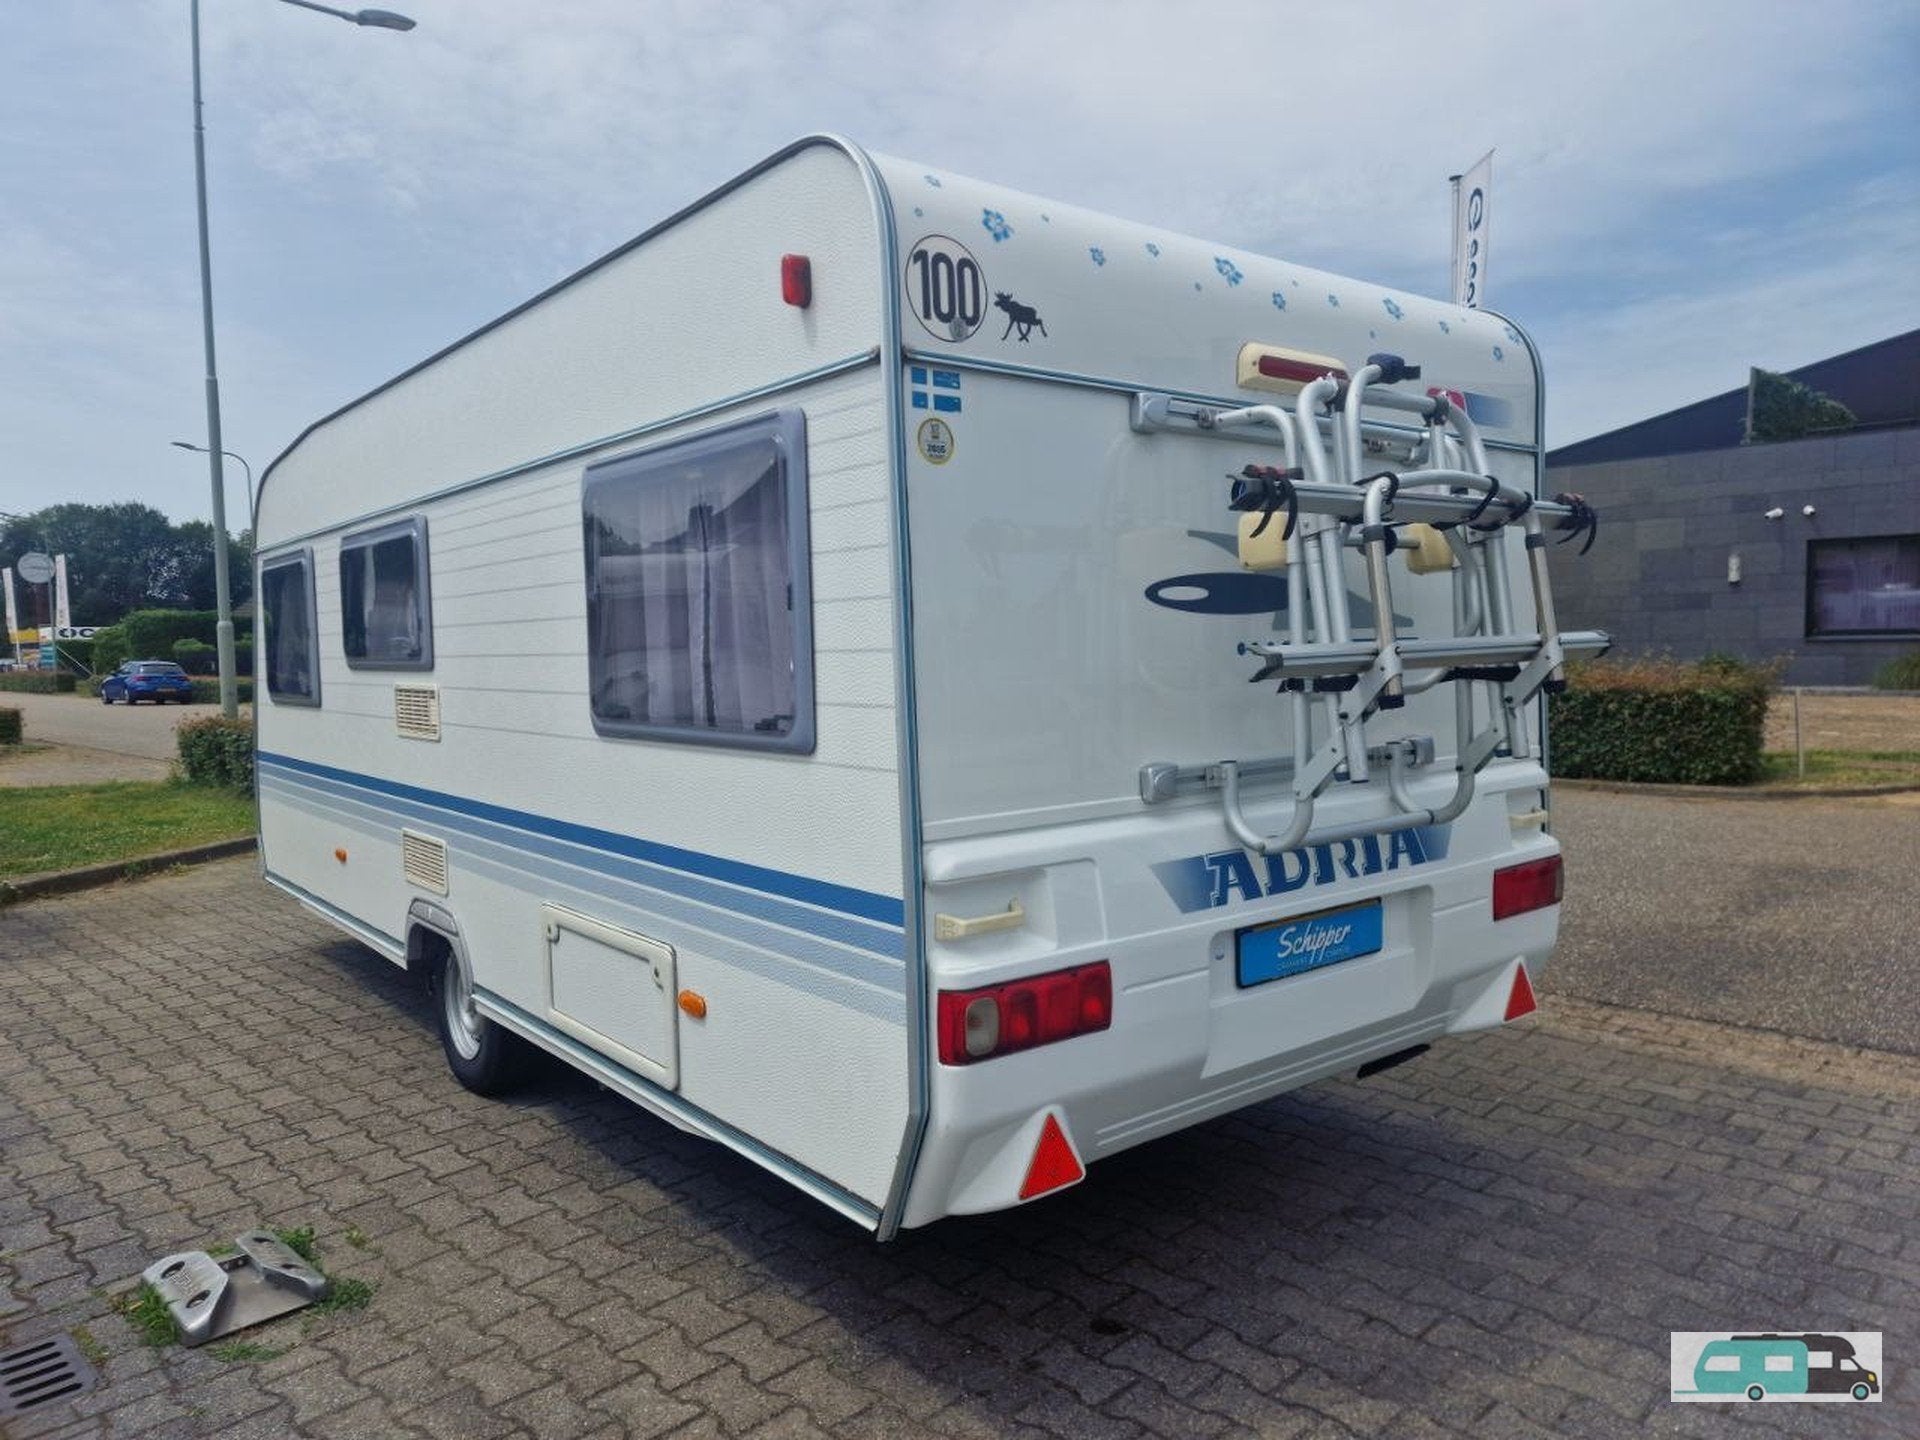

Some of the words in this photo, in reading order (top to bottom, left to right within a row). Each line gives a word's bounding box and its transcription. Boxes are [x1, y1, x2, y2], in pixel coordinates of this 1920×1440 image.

[913, 249, 980, 327] 100
[1204, 828, 1427, 908] ADRIA
[1277, 921, 1351, 965] Schipper
